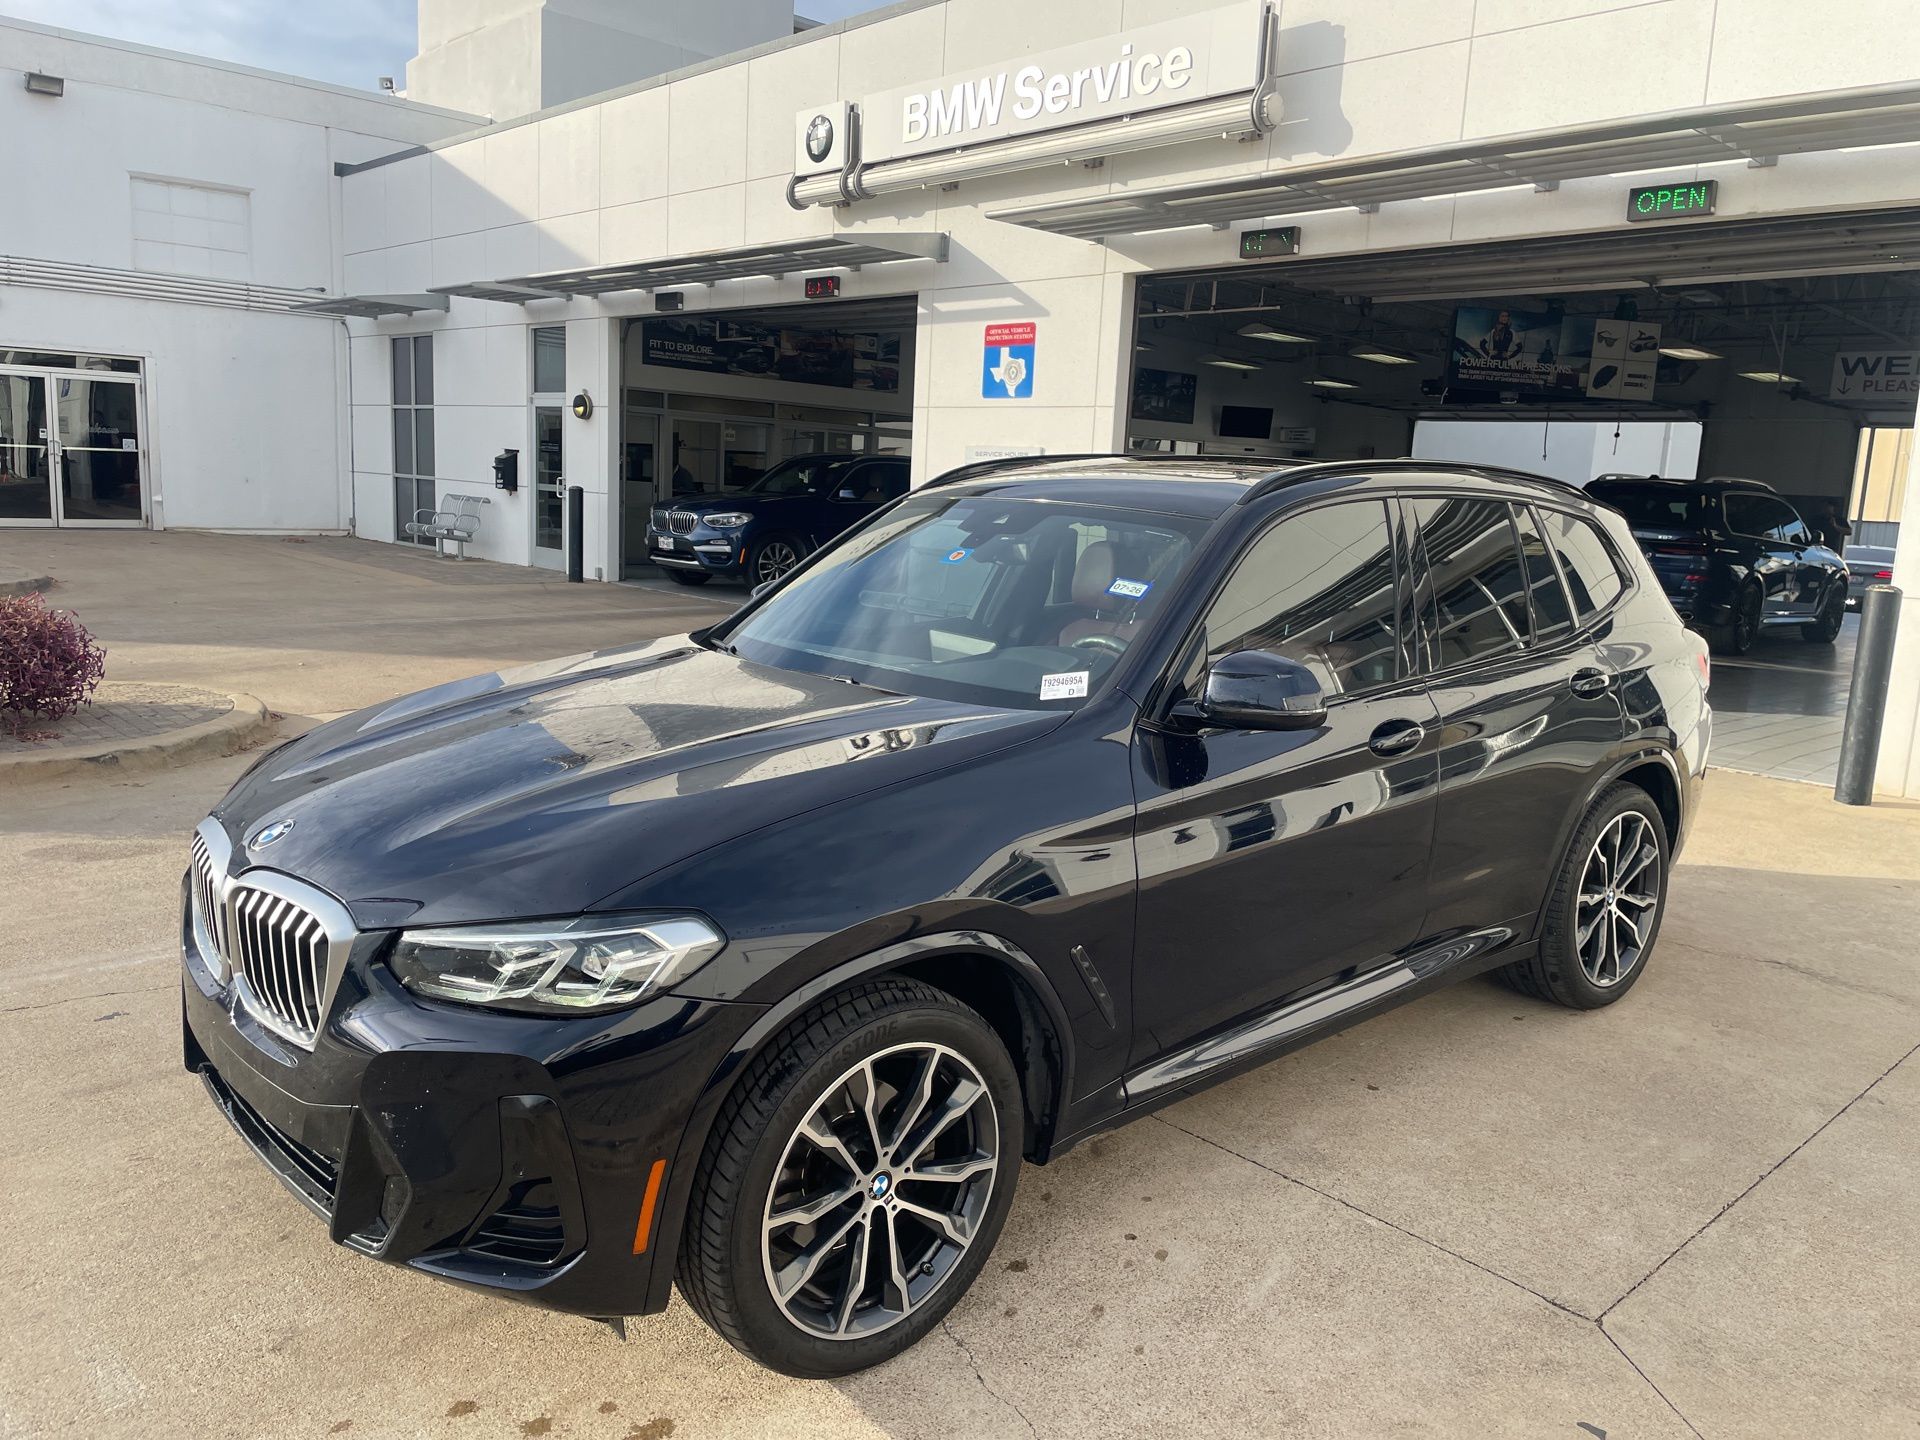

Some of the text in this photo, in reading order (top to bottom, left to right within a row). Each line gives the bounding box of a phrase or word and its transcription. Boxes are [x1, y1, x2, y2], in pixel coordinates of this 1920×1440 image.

[901, 44, 1193, 144] BMW Service
[1637, 186, 1706, 213] OPEN
[989, 326, 1031, 335] OFFICIAL VEHICLE
[986, 334, 1013, 342] INSPECTION
[664, 340, 675, 350] TO
[1459, 356, 1509, 370] POWERFUL
[1043, 676, 1083, 687] T9294695A
